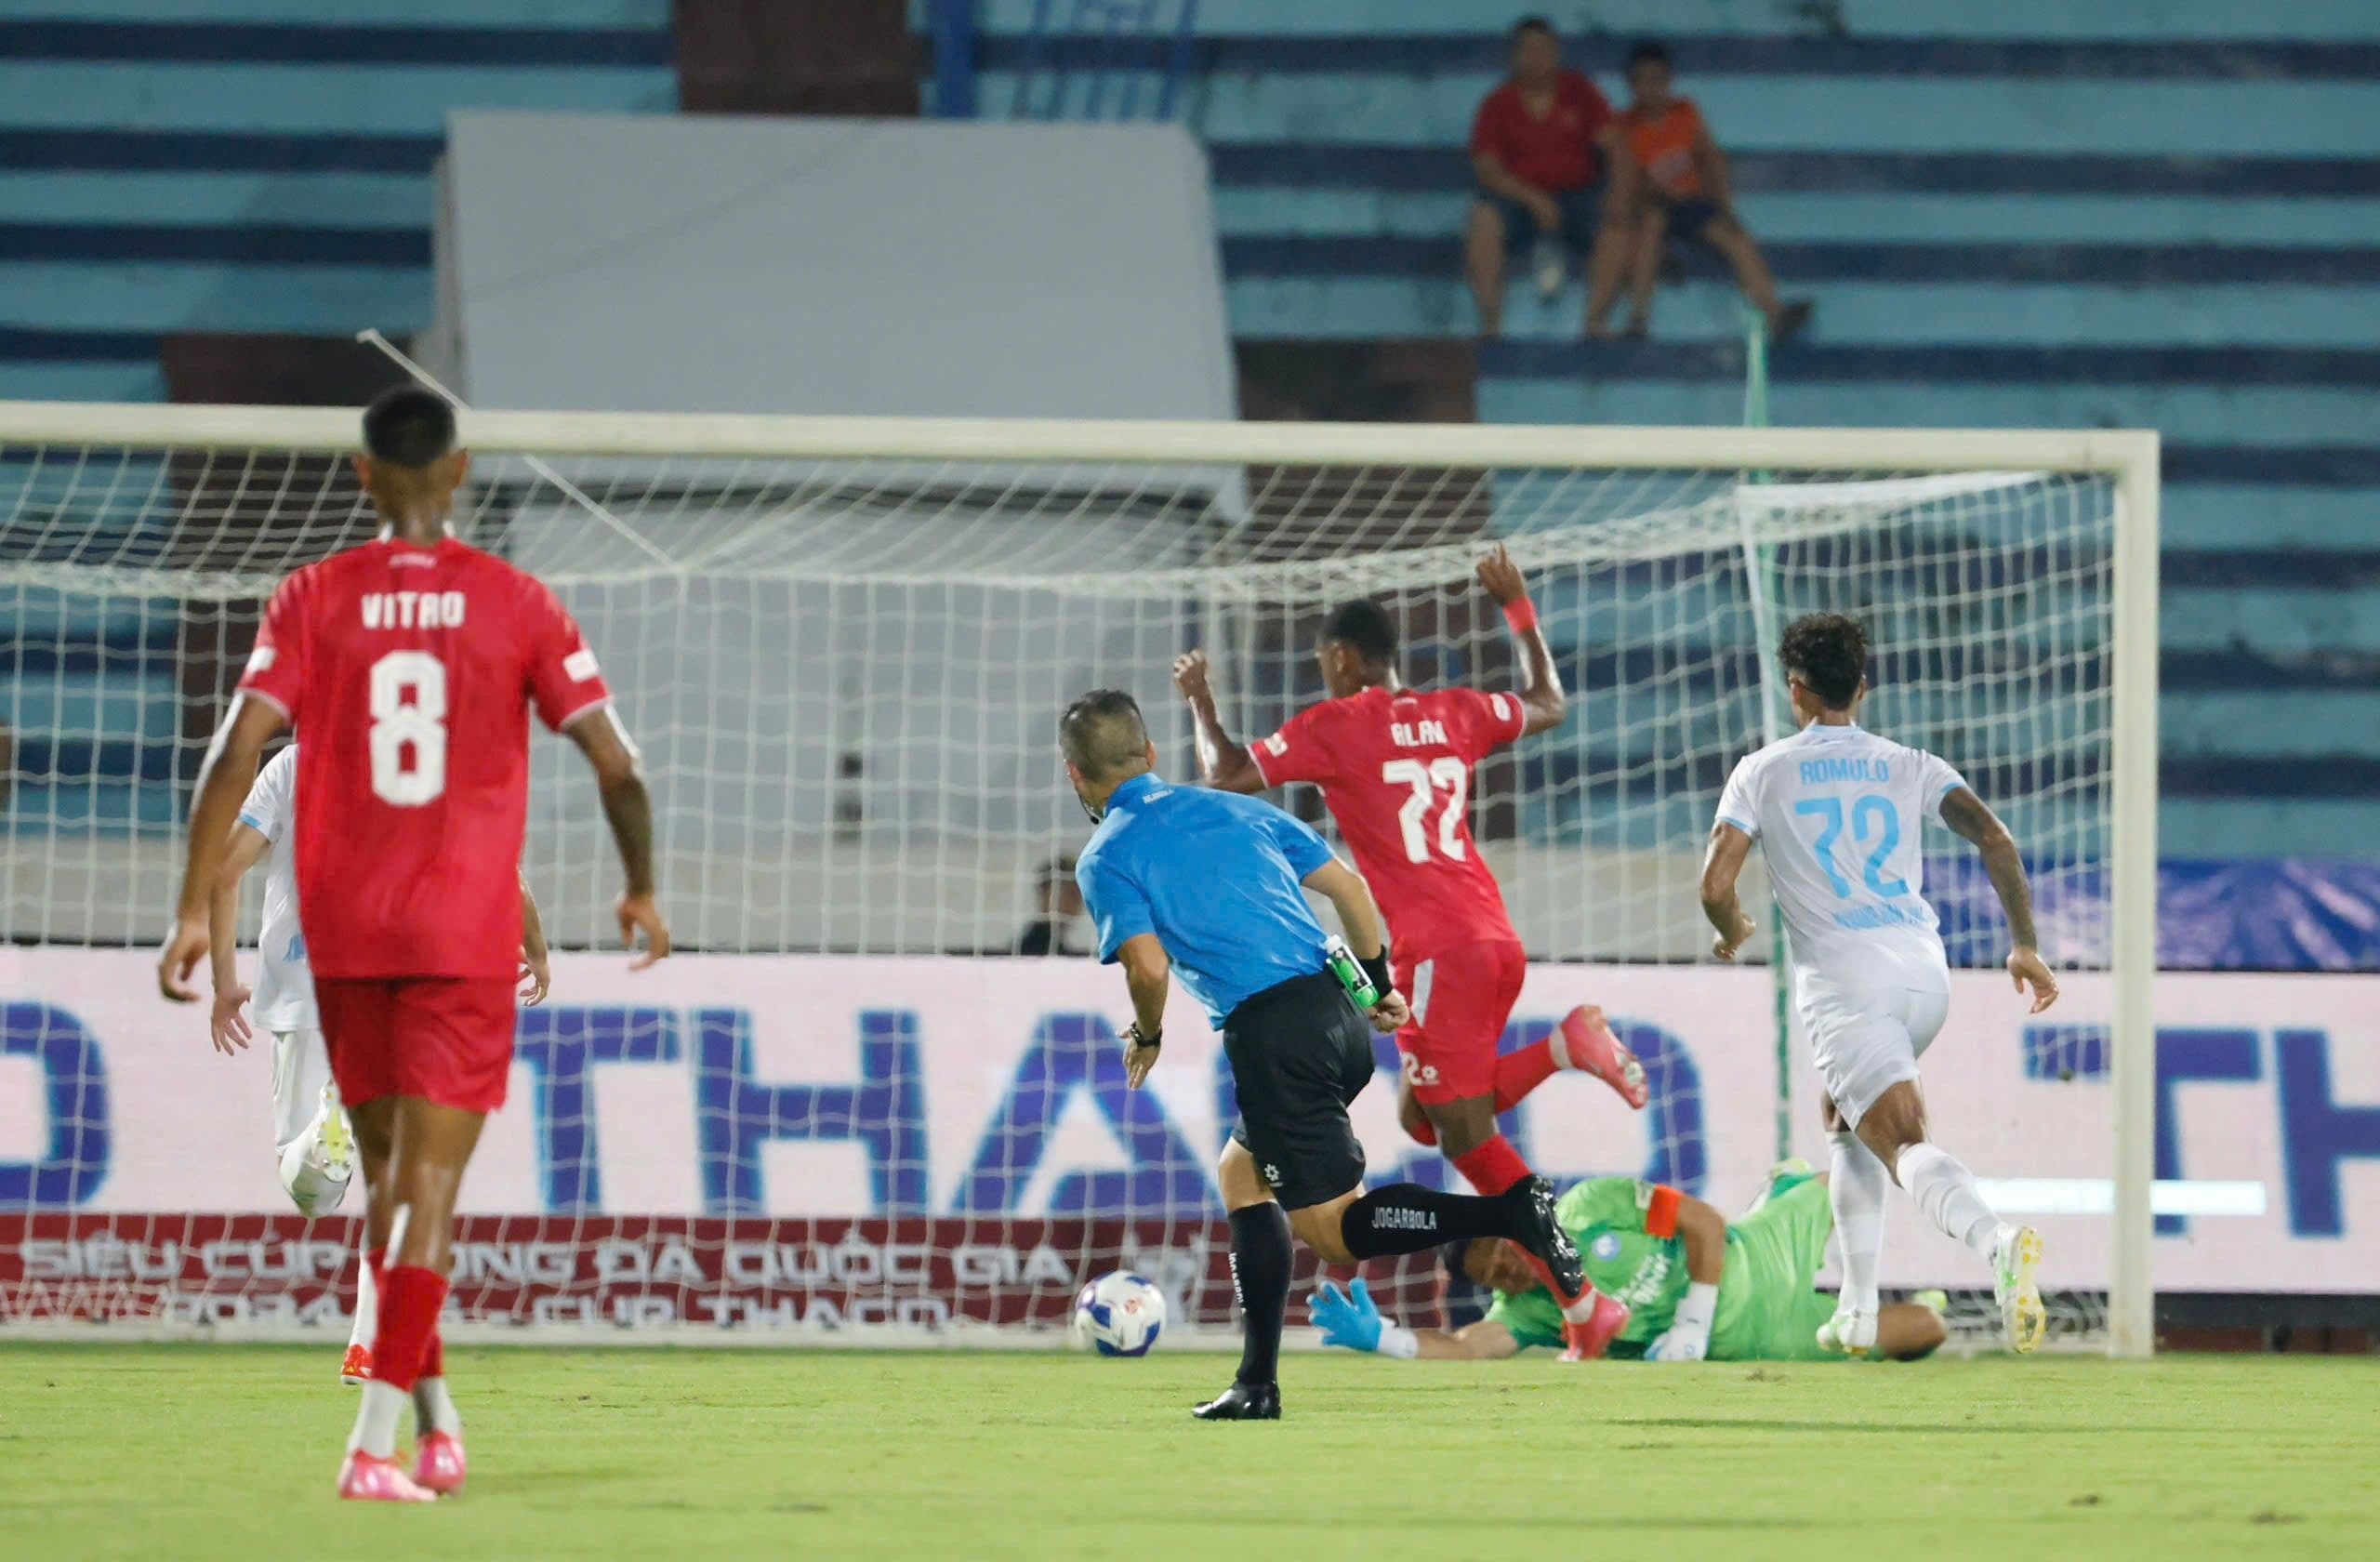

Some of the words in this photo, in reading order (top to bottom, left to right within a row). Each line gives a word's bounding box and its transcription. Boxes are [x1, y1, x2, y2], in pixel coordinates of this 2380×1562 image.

[369, 651, 447, 807] 8
[1799, 758, 1890, 785] ROMULO
[1383, 757, 1468, 863] 72
[1793, 794, 1909, 899] 72
[1371, 1206, 1436, 1230] JOGARBOLA
[450, 1241, 575, 1282] NG
[951, 1243, 1075, 1285] GIA
